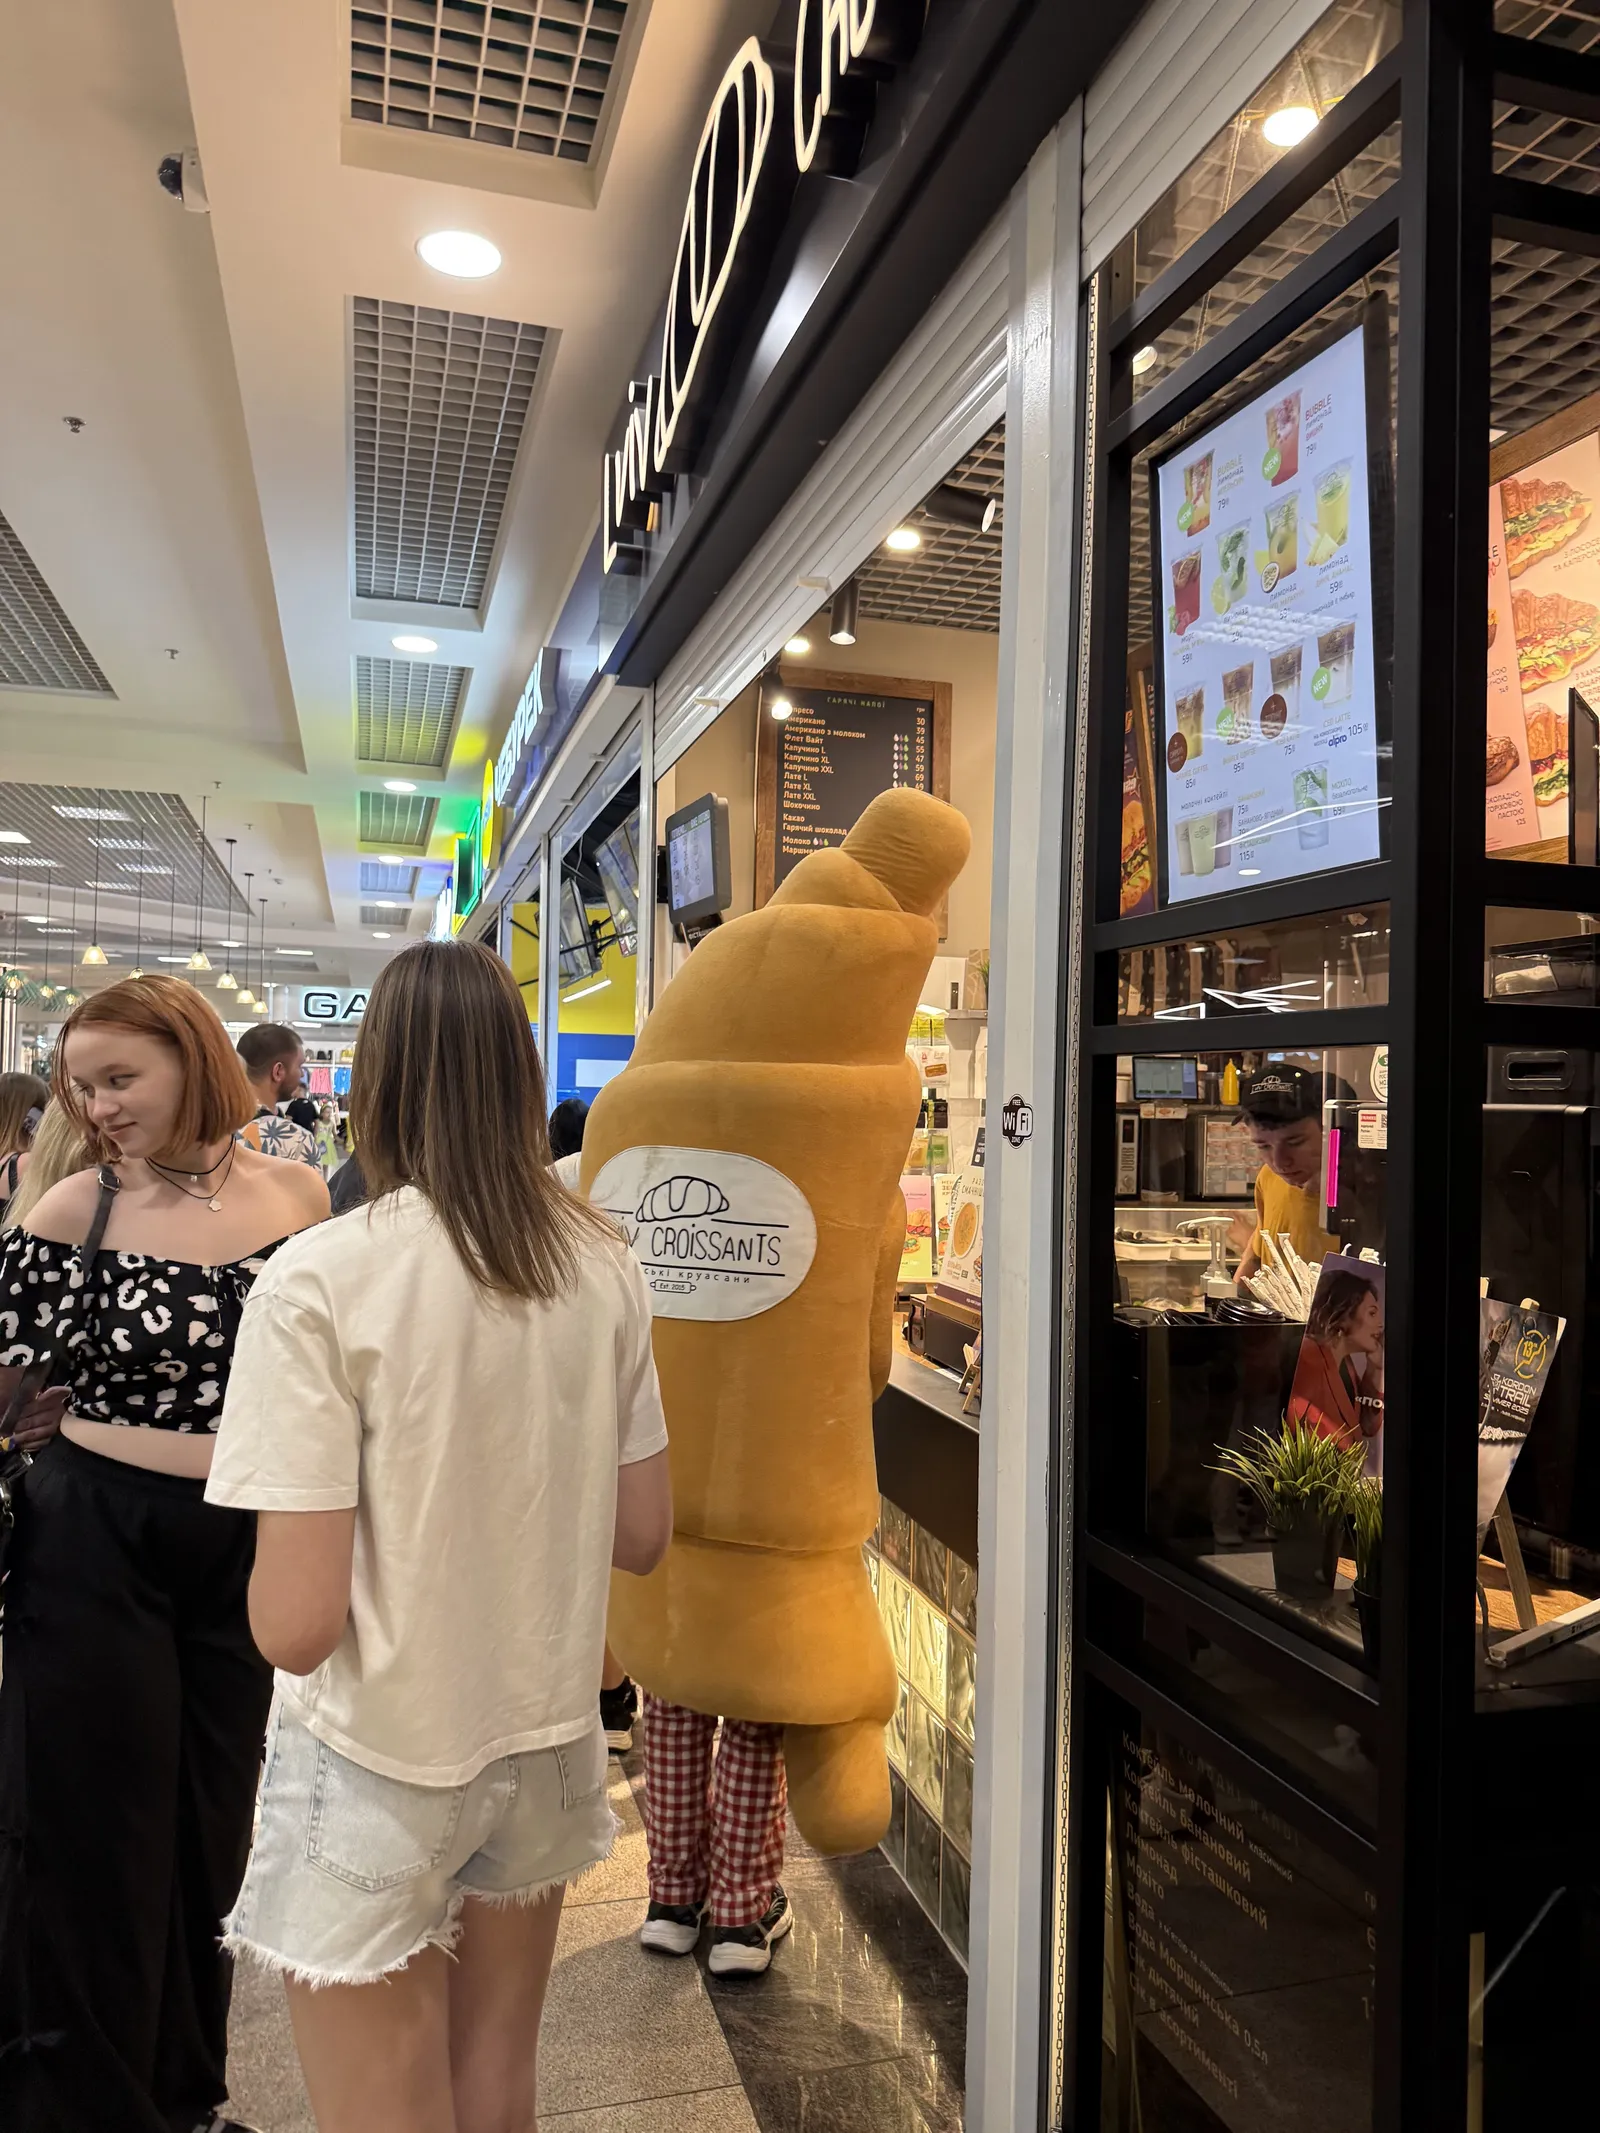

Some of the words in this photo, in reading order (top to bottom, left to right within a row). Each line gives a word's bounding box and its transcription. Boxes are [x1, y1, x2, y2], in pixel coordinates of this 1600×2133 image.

[1313, 673, 1329, 694] NEW
[784, 724, 826, 735] Американо
[784, 743, 820, 754] Капучино
[1328, 734, 1348, 748] alpro
[783, 762, 820, 772] Капучино
[784, 753, 820, 763] Капучино
[783, 801, 821, 811] Шокочино
[1502, 1376, 1537, 1396] KORDON
[1500, 1385, 1532, 1409] TRAIL
[1510, 1402, 1530, 1416] 2025
[1179, 1779, 1244, 1844] молочний
[1126, 1822, 1178, 1886] Лимонад
[1179, 1807, 1251, 1883] банановий
[1126, 1851, 1165, 1900] Мохіто
[1180, 1839, 1268, 1932] фісташковий
[1127, 1880, 1156, 1922] Вода
[1127, 1910, 1157, 1953] Вода
[1159, 1941, 1241, 2040] Моршинська
